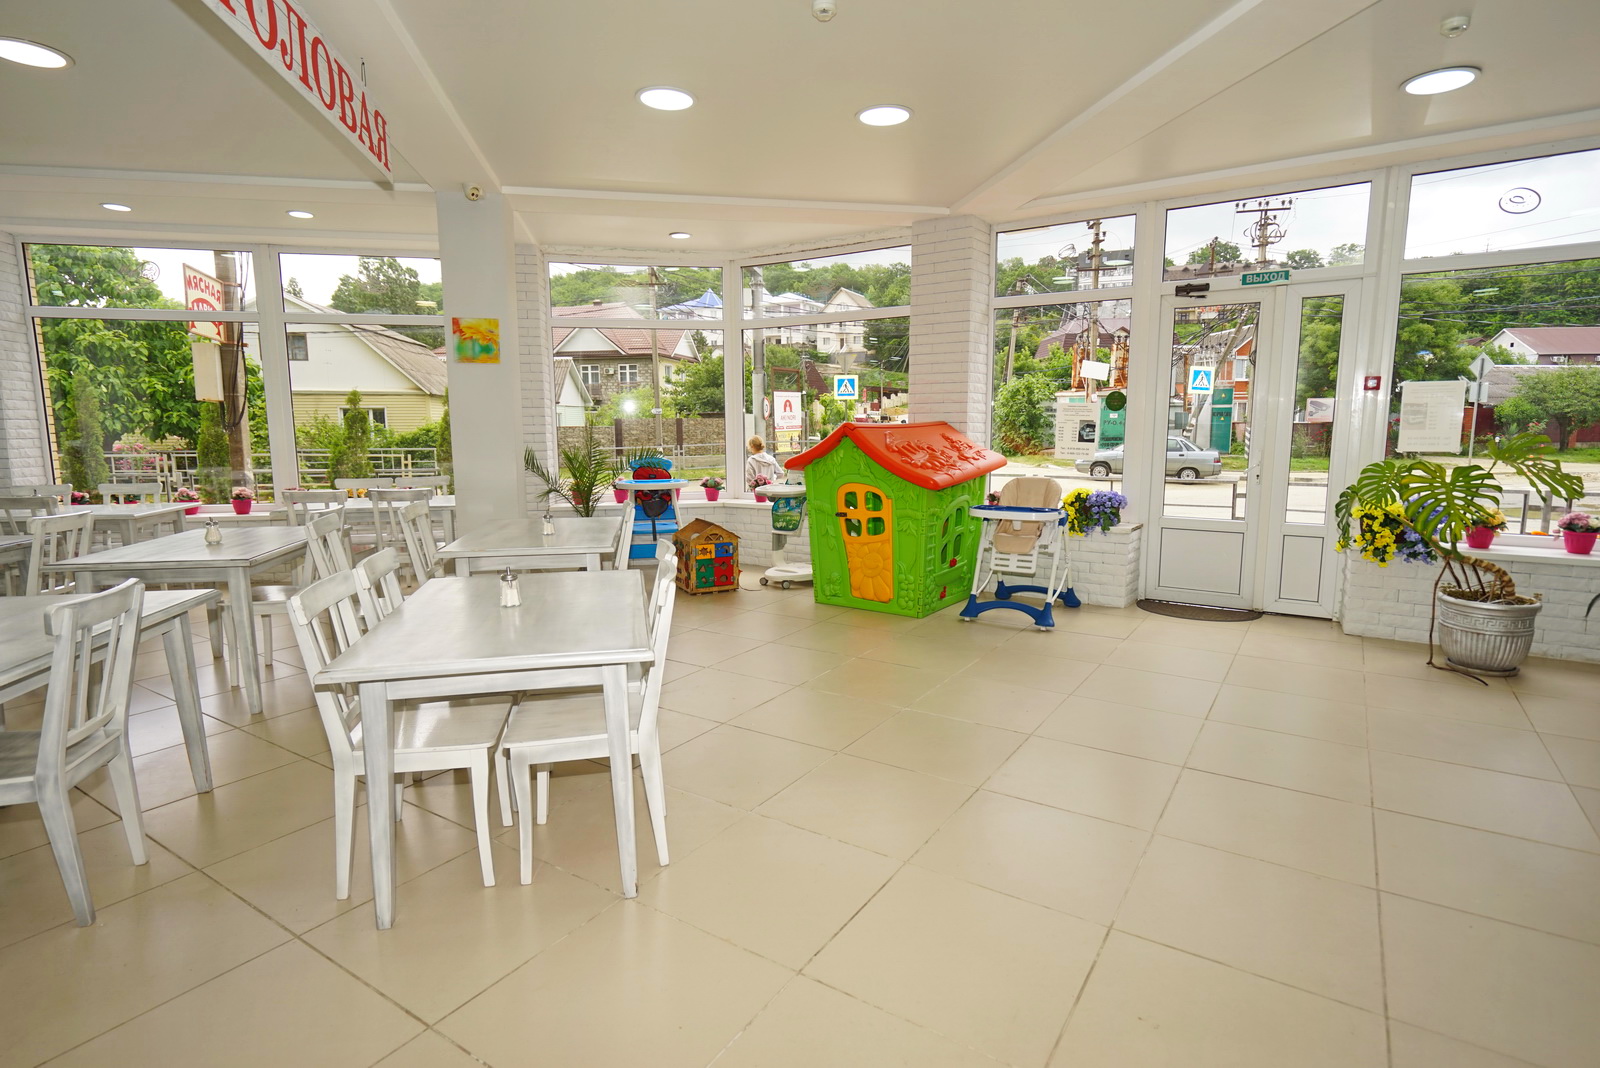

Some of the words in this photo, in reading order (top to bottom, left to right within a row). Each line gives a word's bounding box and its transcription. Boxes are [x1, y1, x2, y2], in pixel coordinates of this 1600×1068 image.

[219, 0, 391, 172] ОЛОВАЯ
[187, 275, 220, 304] МЯСНАЯ
[1246, 272, 1285, 283] ВЫХОД
